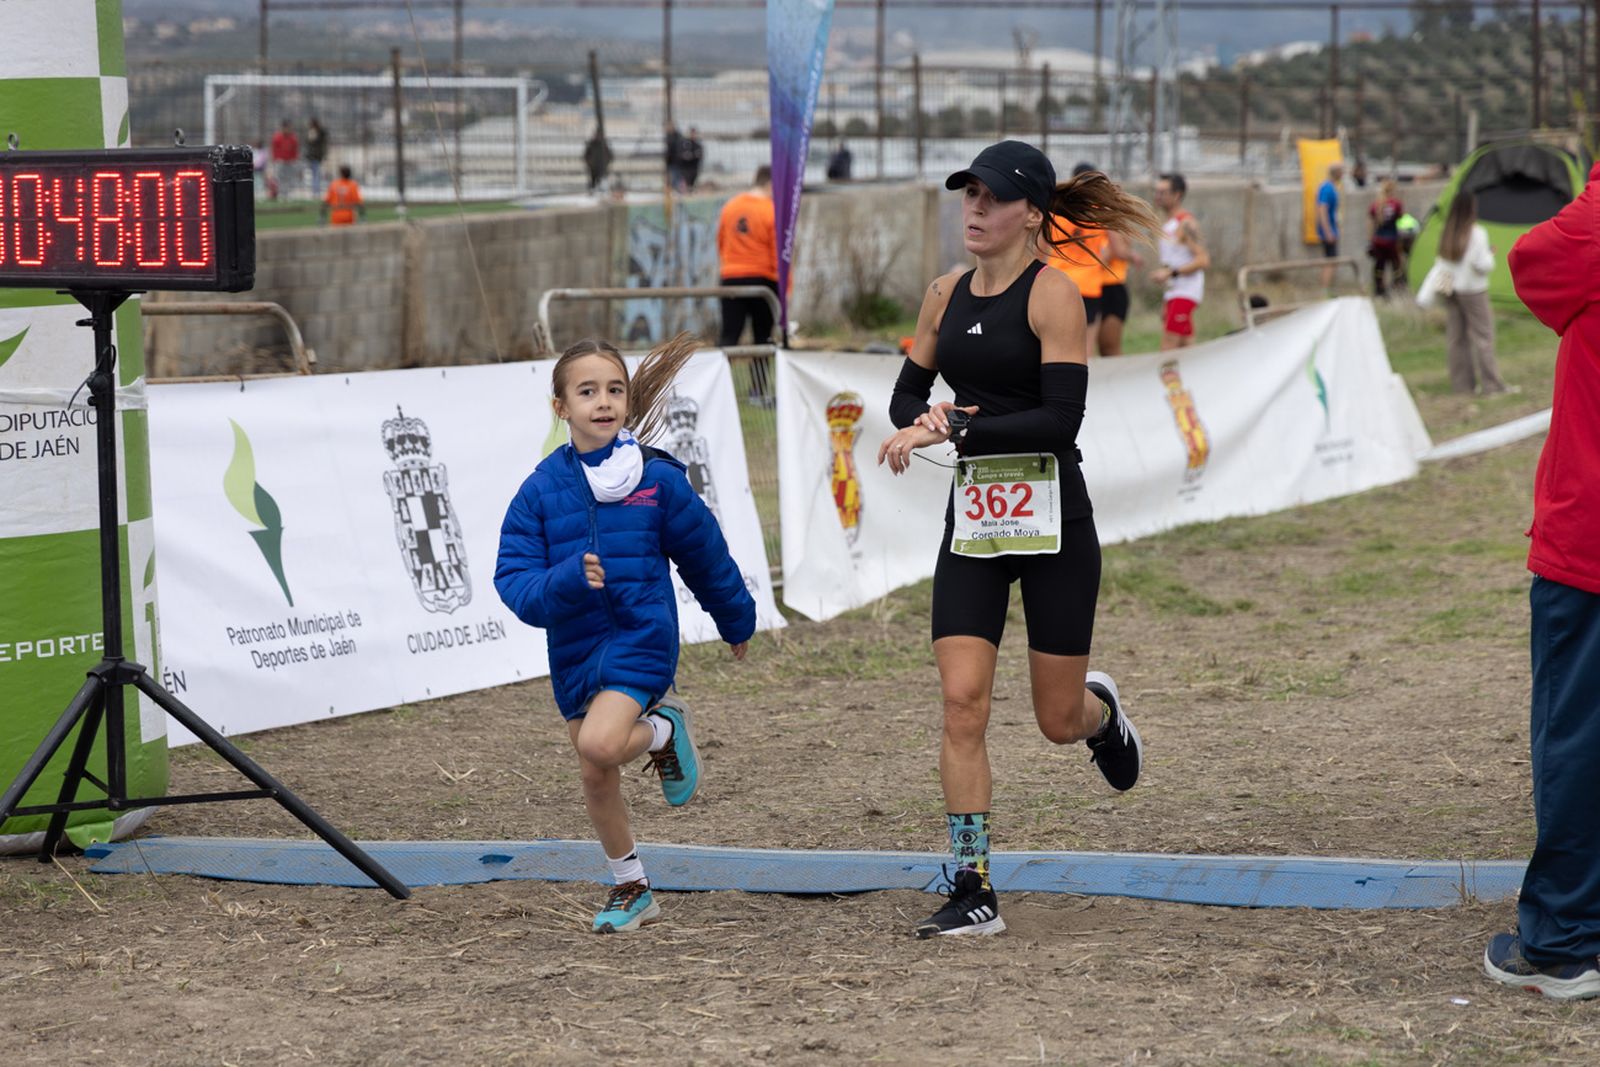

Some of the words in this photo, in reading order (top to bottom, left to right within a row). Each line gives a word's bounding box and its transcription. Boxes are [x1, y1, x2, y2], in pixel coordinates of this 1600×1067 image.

[0, 408, 98, 433] DIPUTACIO
[0, 441, 27, 460] DE
[32, 434, 80, 459] JAÉN
[964, 482, 1034, 521] 362
[1013, 528, 1040, 538] Moya
[226, 621, 287, 646] Patronato
[287, 611, 346, 637] Municipal
[346, 608, 362, 628] de
[407, 628, 454, 654] CIUDAD
[454, 625, 474, 646] DE
[475, 616, 506, 643] JAÉN
[250, 646, 309, 672] Deportes
[310, 641, 326, 660] de
[328, 636, 357, 658] Jaén
[163, 666, 187, 693] ÉN
